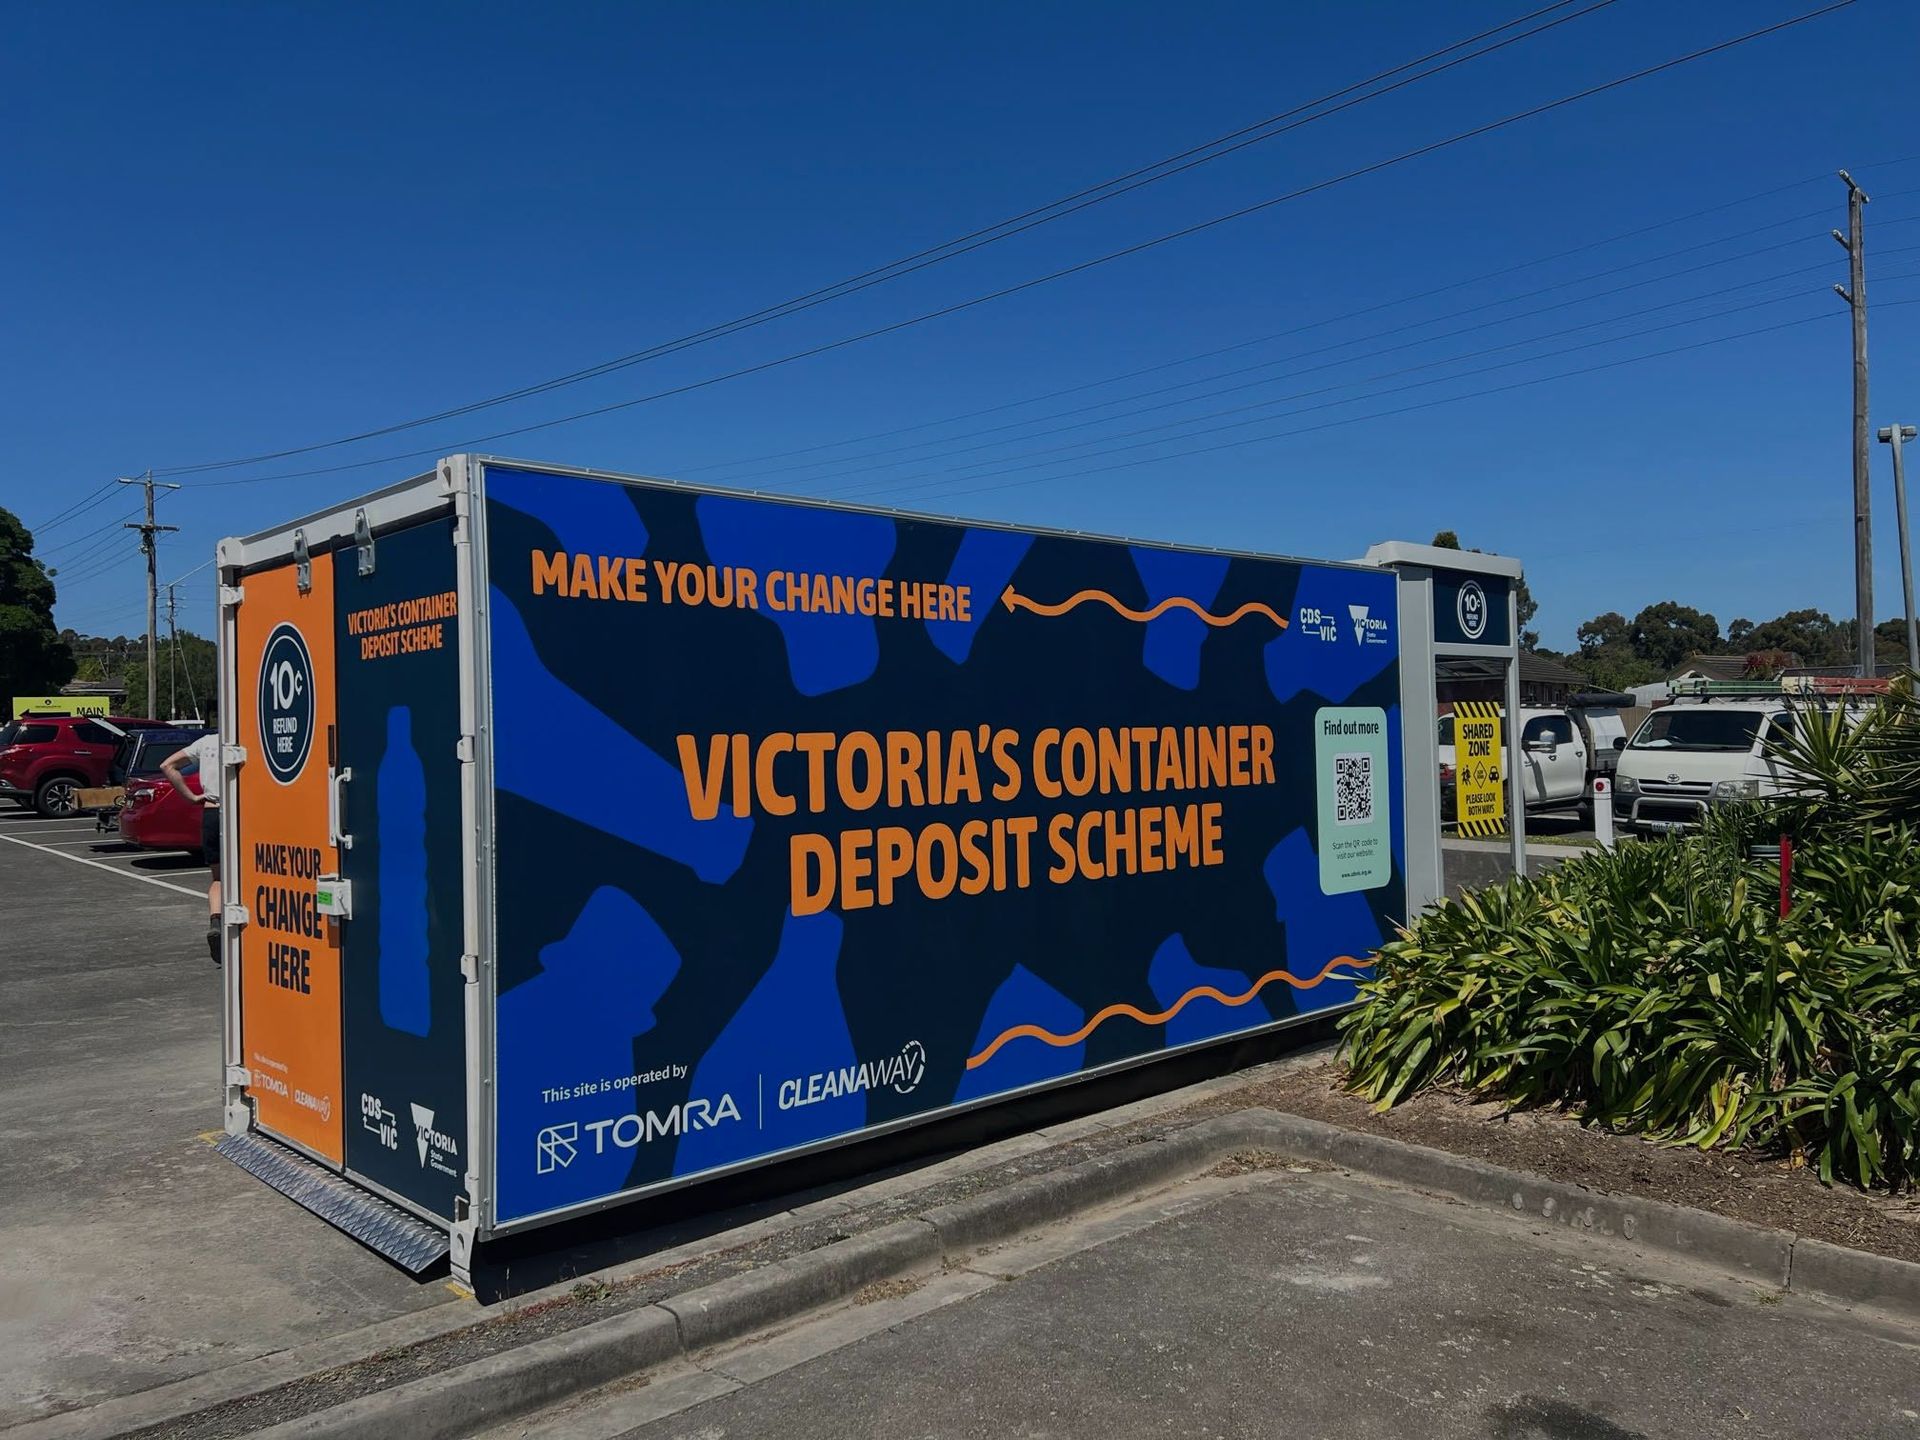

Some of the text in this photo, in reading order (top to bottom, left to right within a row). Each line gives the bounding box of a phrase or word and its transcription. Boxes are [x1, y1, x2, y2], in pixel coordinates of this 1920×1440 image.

[530, 549, 972, 622] MAKE YOUR CHANGE HERE
[347, 591, 458, 635] VICTORIA'S CONTAINER
[1300, 607, 1321, 625] CDS
[1354, 618, 1388, 630] VICTORIA
[361, 624, 443, 660] DEPOSIT SCHEME
[1319, 625, 1337, 642] VIC
[76, 707, 104, 716] MAIN
[272, 717, 298, 734] REFUND
[1323, 718, 1379, 735] Find out more
[1462, 723, 1494, 740] SHARED
[277, 737, 293, 753] HERE
[1468, 740, 1490, 757] ZONE
[676, 723, 1276, 821] VICTORIA'S CONTAINER
[1466, 792, 1496, 804] PLEASE LOOK
[1468, 804, 1495, 816] BOTH WAYS
[255, 842, 321, 880] MAKE YOUR
[789, 802, 1225, 918] DEPOSIT SCHEME
[256, 885, 323, 939] CHANGE
[268, 942, 311, 995] HERE
[541, 1064, 688, 1104] This site is operated by
[361, 1092, 382, 1120] CDS
[584, 1050, 921, 1154] TOMRA CLEANAWAY
[379, 1122, 398, 1151] VIC
[415, 1124, 458, 1156] VICTORIA
